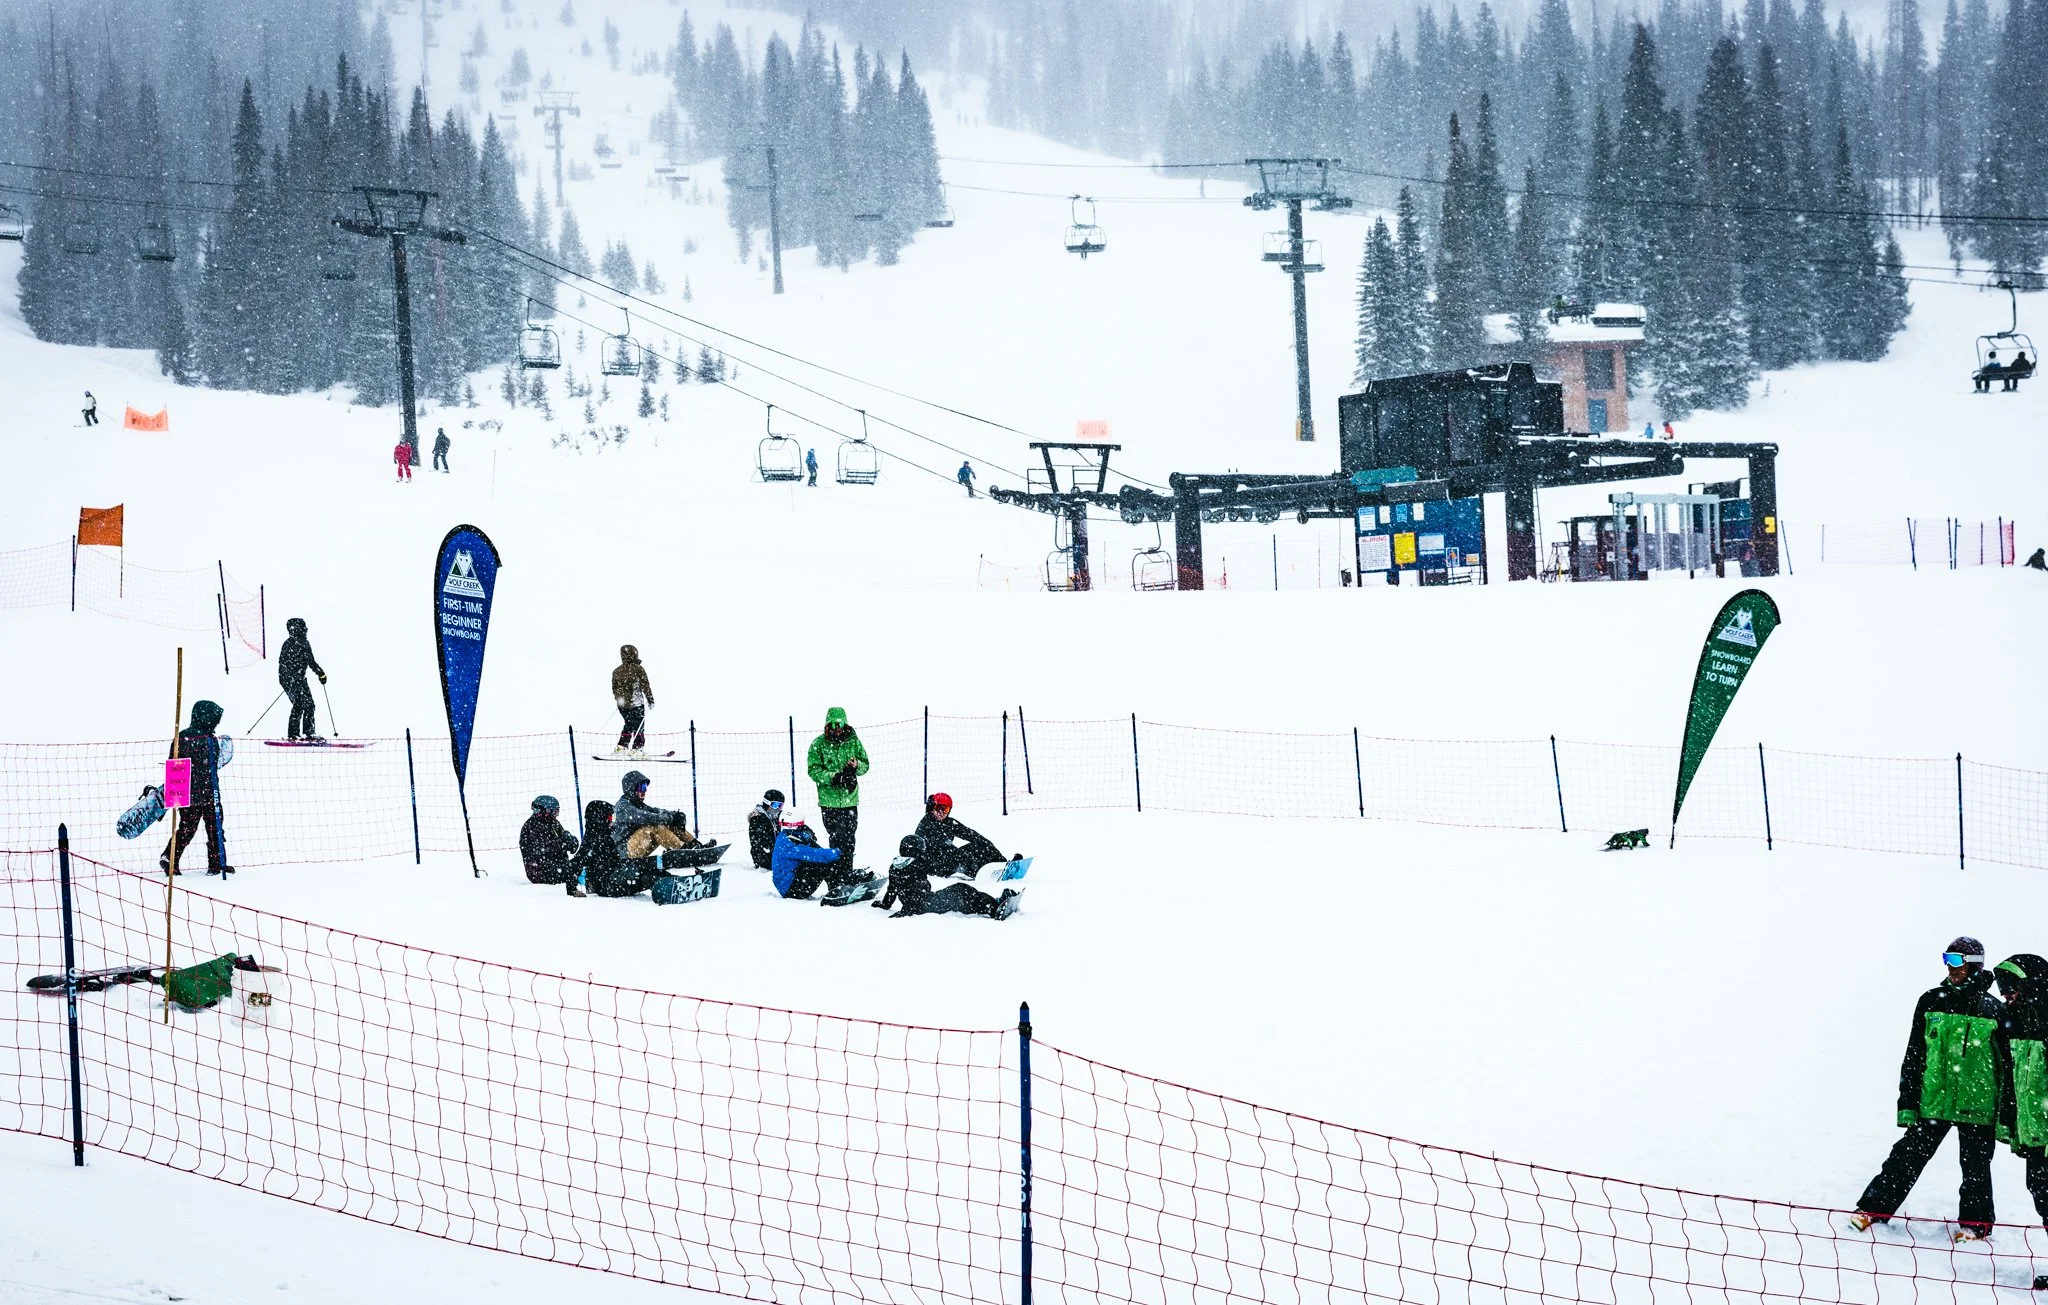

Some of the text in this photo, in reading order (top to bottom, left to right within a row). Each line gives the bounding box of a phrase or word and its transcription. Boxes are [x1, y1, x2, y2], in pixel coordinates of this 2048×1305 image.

[463, 581, 480, 590] CREEK
[443, 597, 483, 615] FIRST-TIME
[442, 613, 482, 630] BEGINNER
[443, 627, 480, 641] SNOWBOARD
[1710, 649, 1752, 665] SNOWBOARD
[1712, 660, 1739, 674] LEARN
[1705, 671, 1739, 688] TO TURN
